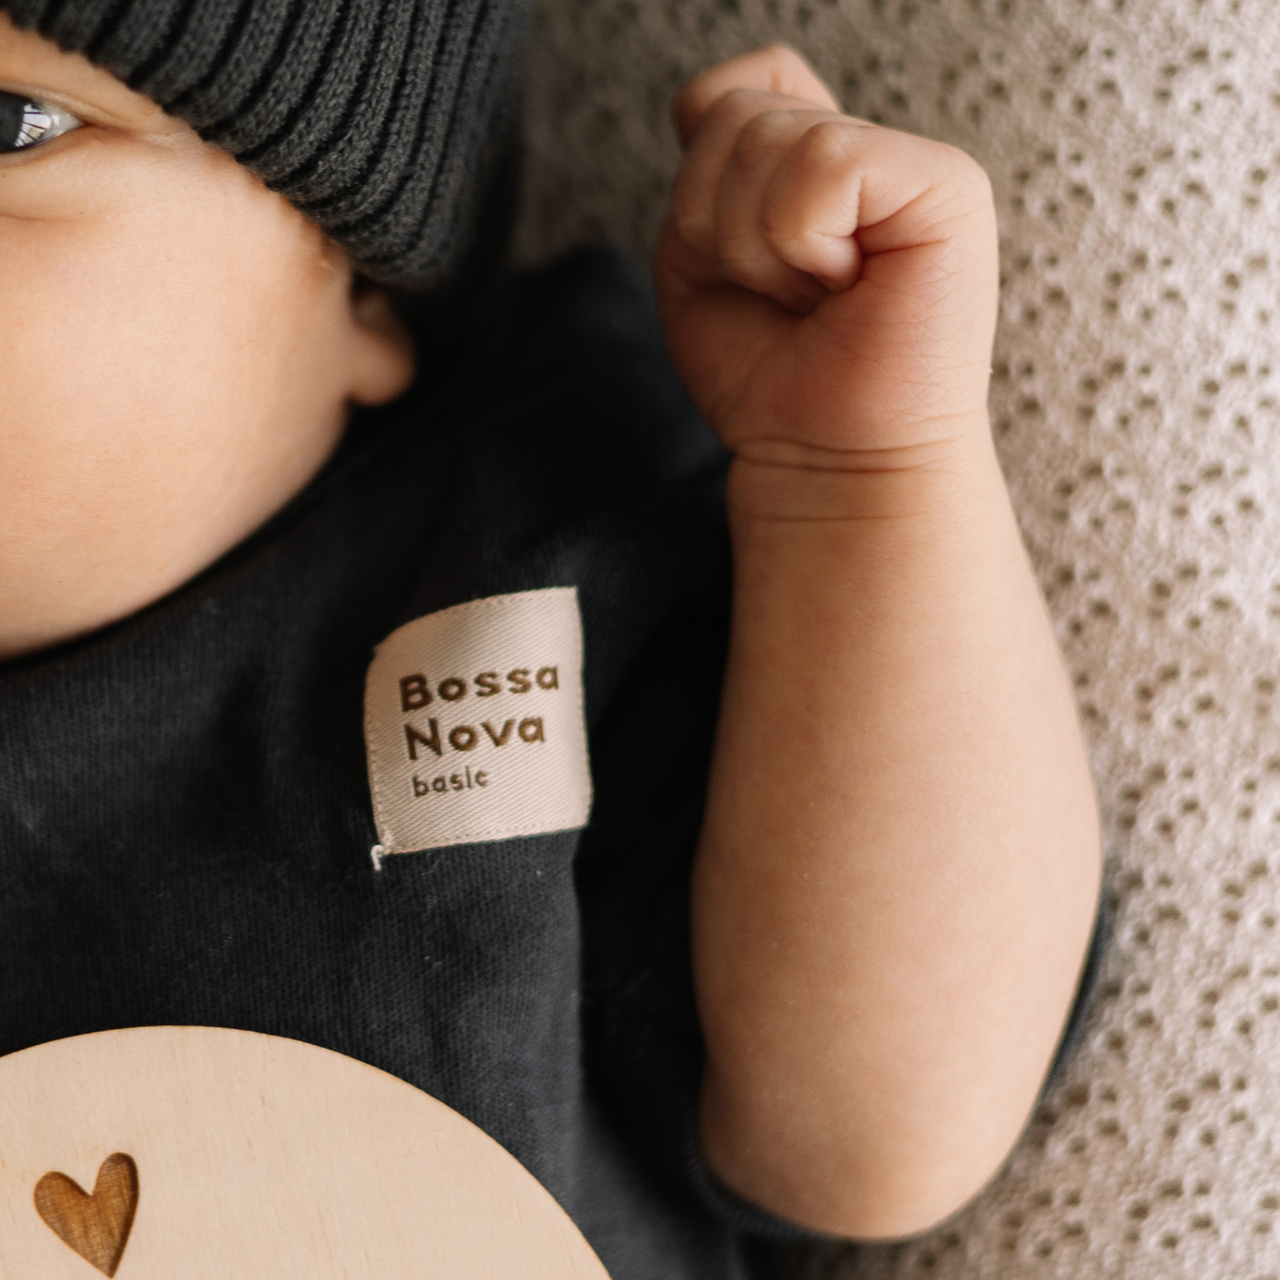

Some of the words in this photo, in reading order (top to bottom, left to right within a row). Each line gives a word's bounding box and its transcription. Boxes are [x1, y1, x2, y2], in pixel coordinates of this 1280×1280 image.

[399, 666, 559, 712] Bossa
[404, 716, 545, 760] Nova
[411, 765, 489, 797] basic
